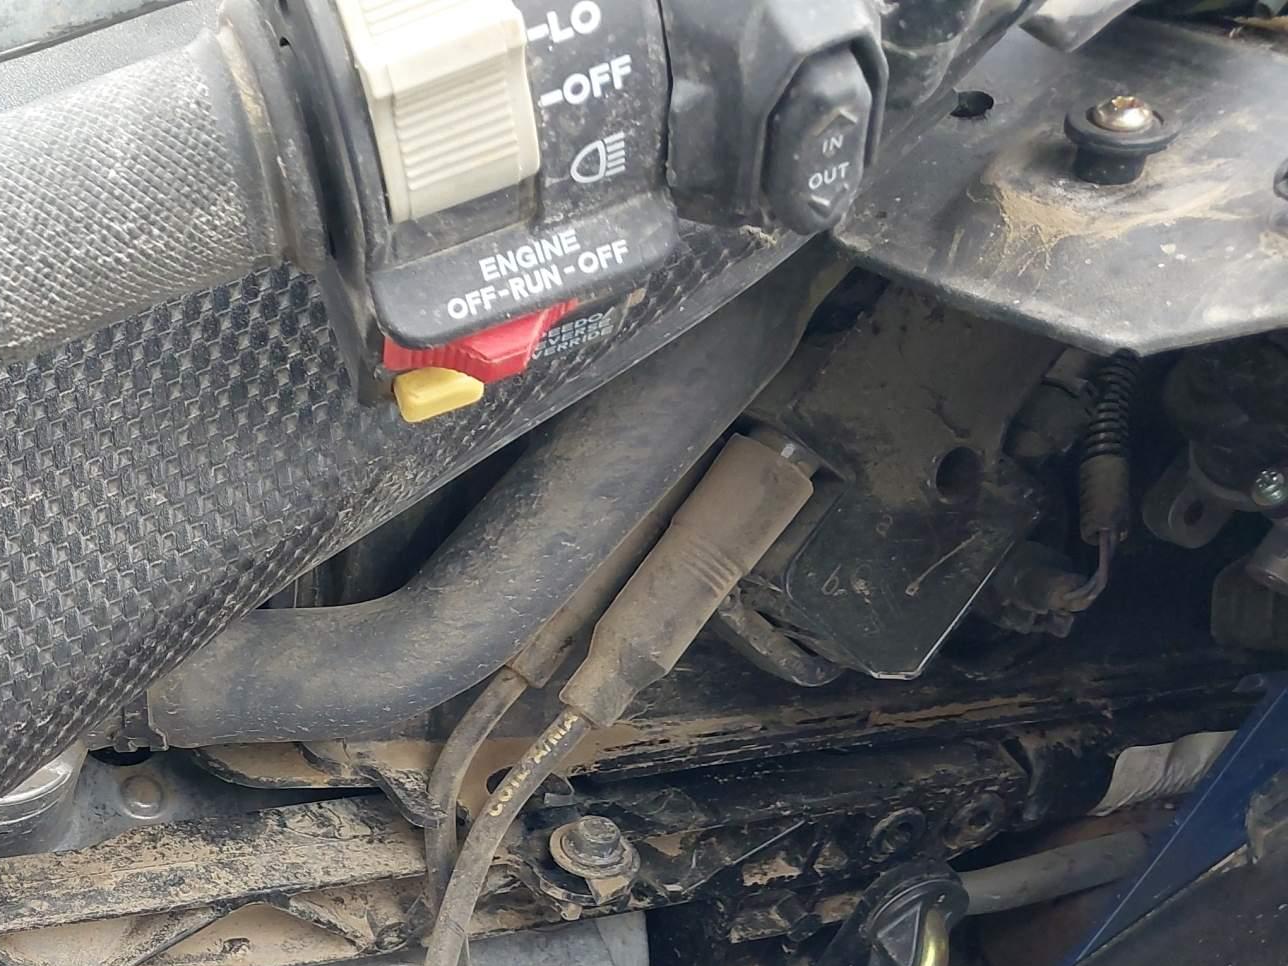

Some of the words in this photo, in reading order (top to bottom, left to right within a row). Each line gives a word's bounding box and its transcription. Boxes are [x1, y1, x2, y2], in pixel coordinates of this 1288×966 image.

[822, 134, 844, 153] IN
[808, 161, 850, 190] OUT
[478, 229, 581, 282] ENGINE
[531, 325, 614, 360] VERRIDE
